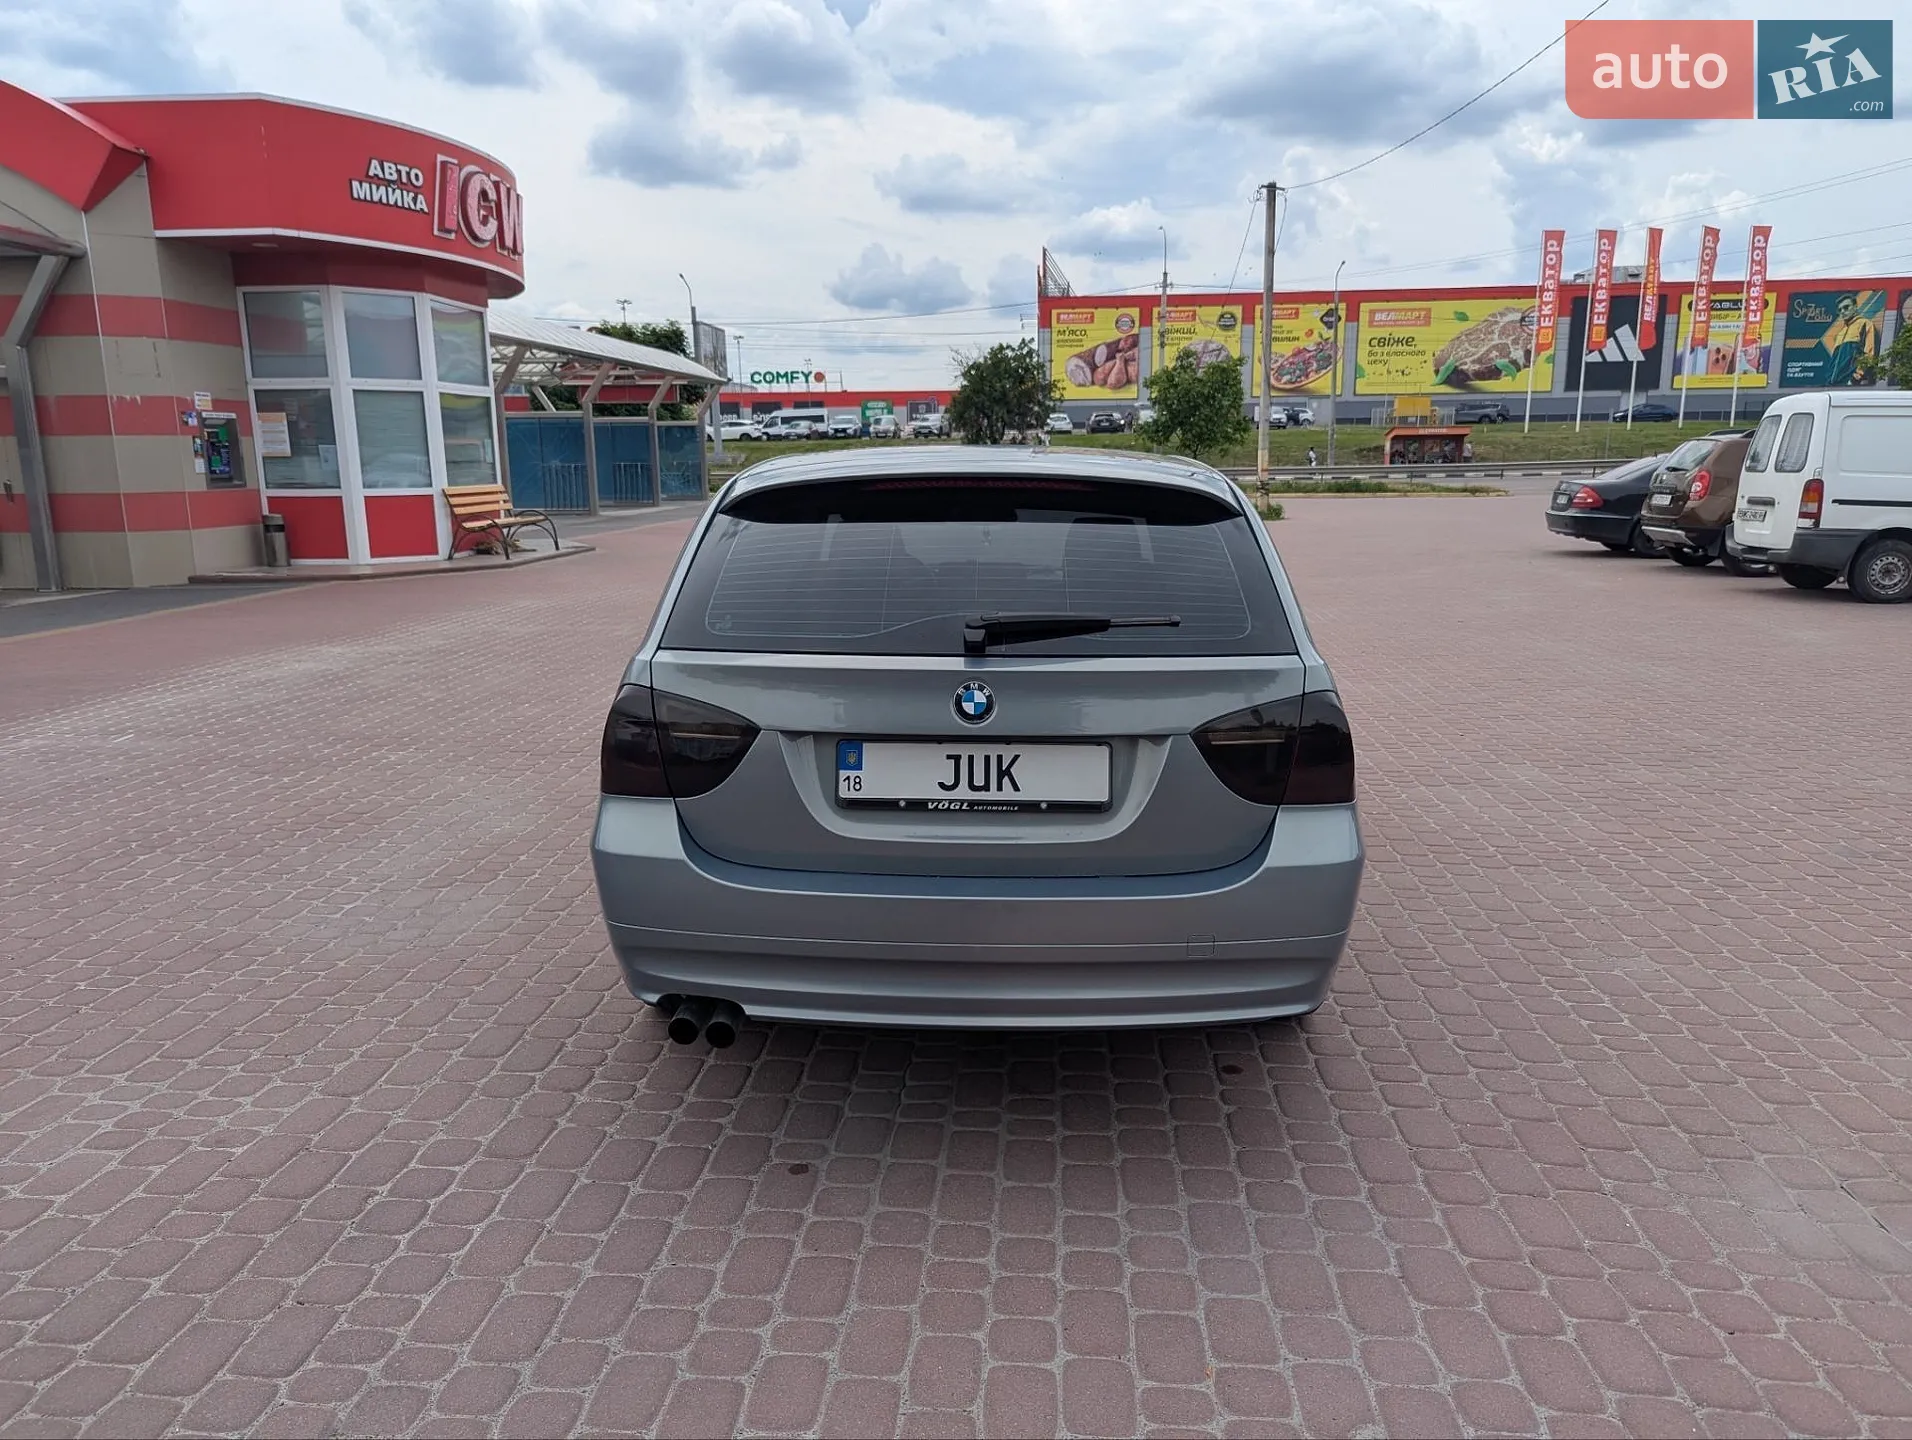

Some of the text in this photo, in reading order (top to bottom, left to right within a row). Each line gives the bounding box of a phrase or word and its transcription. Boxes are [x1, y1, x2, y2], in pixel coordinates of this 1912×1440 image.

[367, 158, 424, 188] АВТО
[351, 179, 430, 214] МИЙКА
[1369, 333, 1417, 348] свіже,
[751, 371, 812, 384] COMFY
[958, 683, 991, 696] BMW
[937, 754, 1022, 792] JUK
[842, 775, 862, 792] 18
[928, 800, 970, 810] VÖGL
